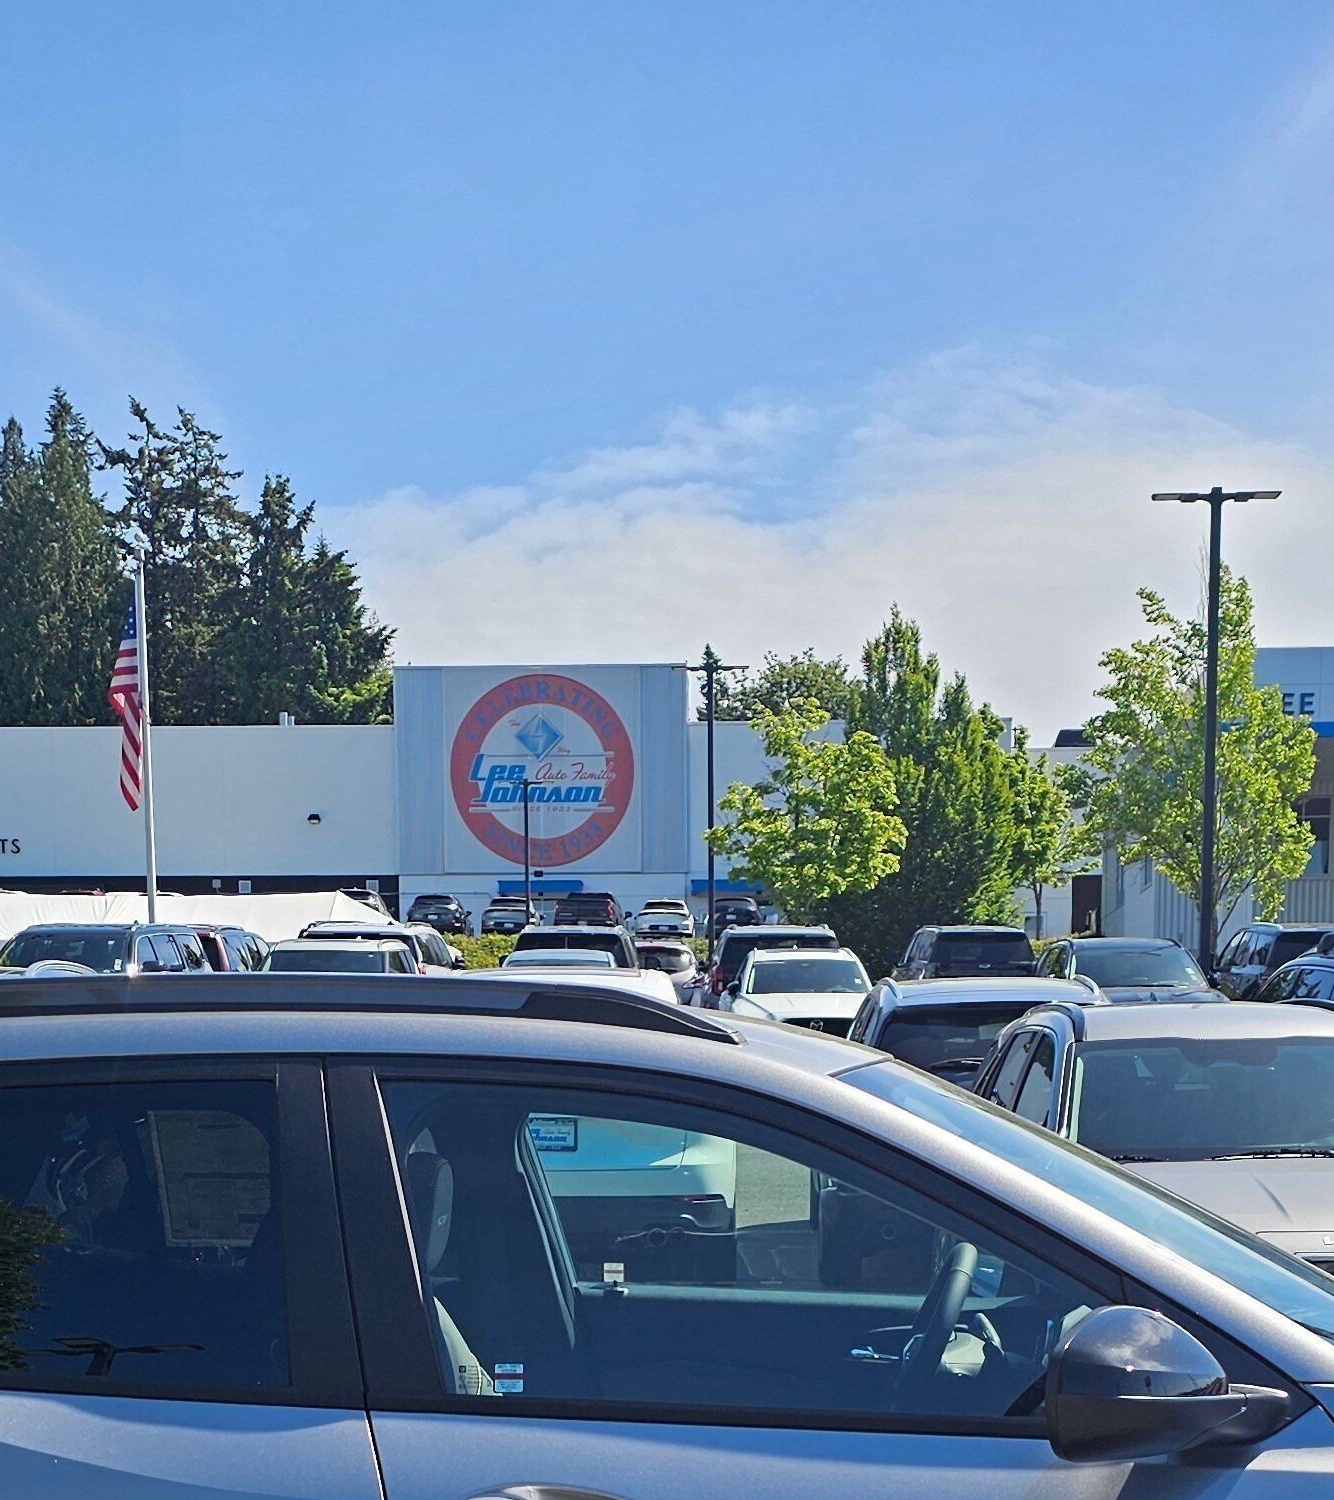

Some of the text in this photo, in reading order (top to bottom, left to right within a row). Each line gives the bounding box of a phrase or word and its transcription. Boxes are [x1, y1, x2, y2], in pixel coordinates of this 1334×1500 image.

[1281, 692, 1316, 714] EE
[469, 753, 616, 785] Lee Auto Family
[472, 778, 605, 803] Johnson
